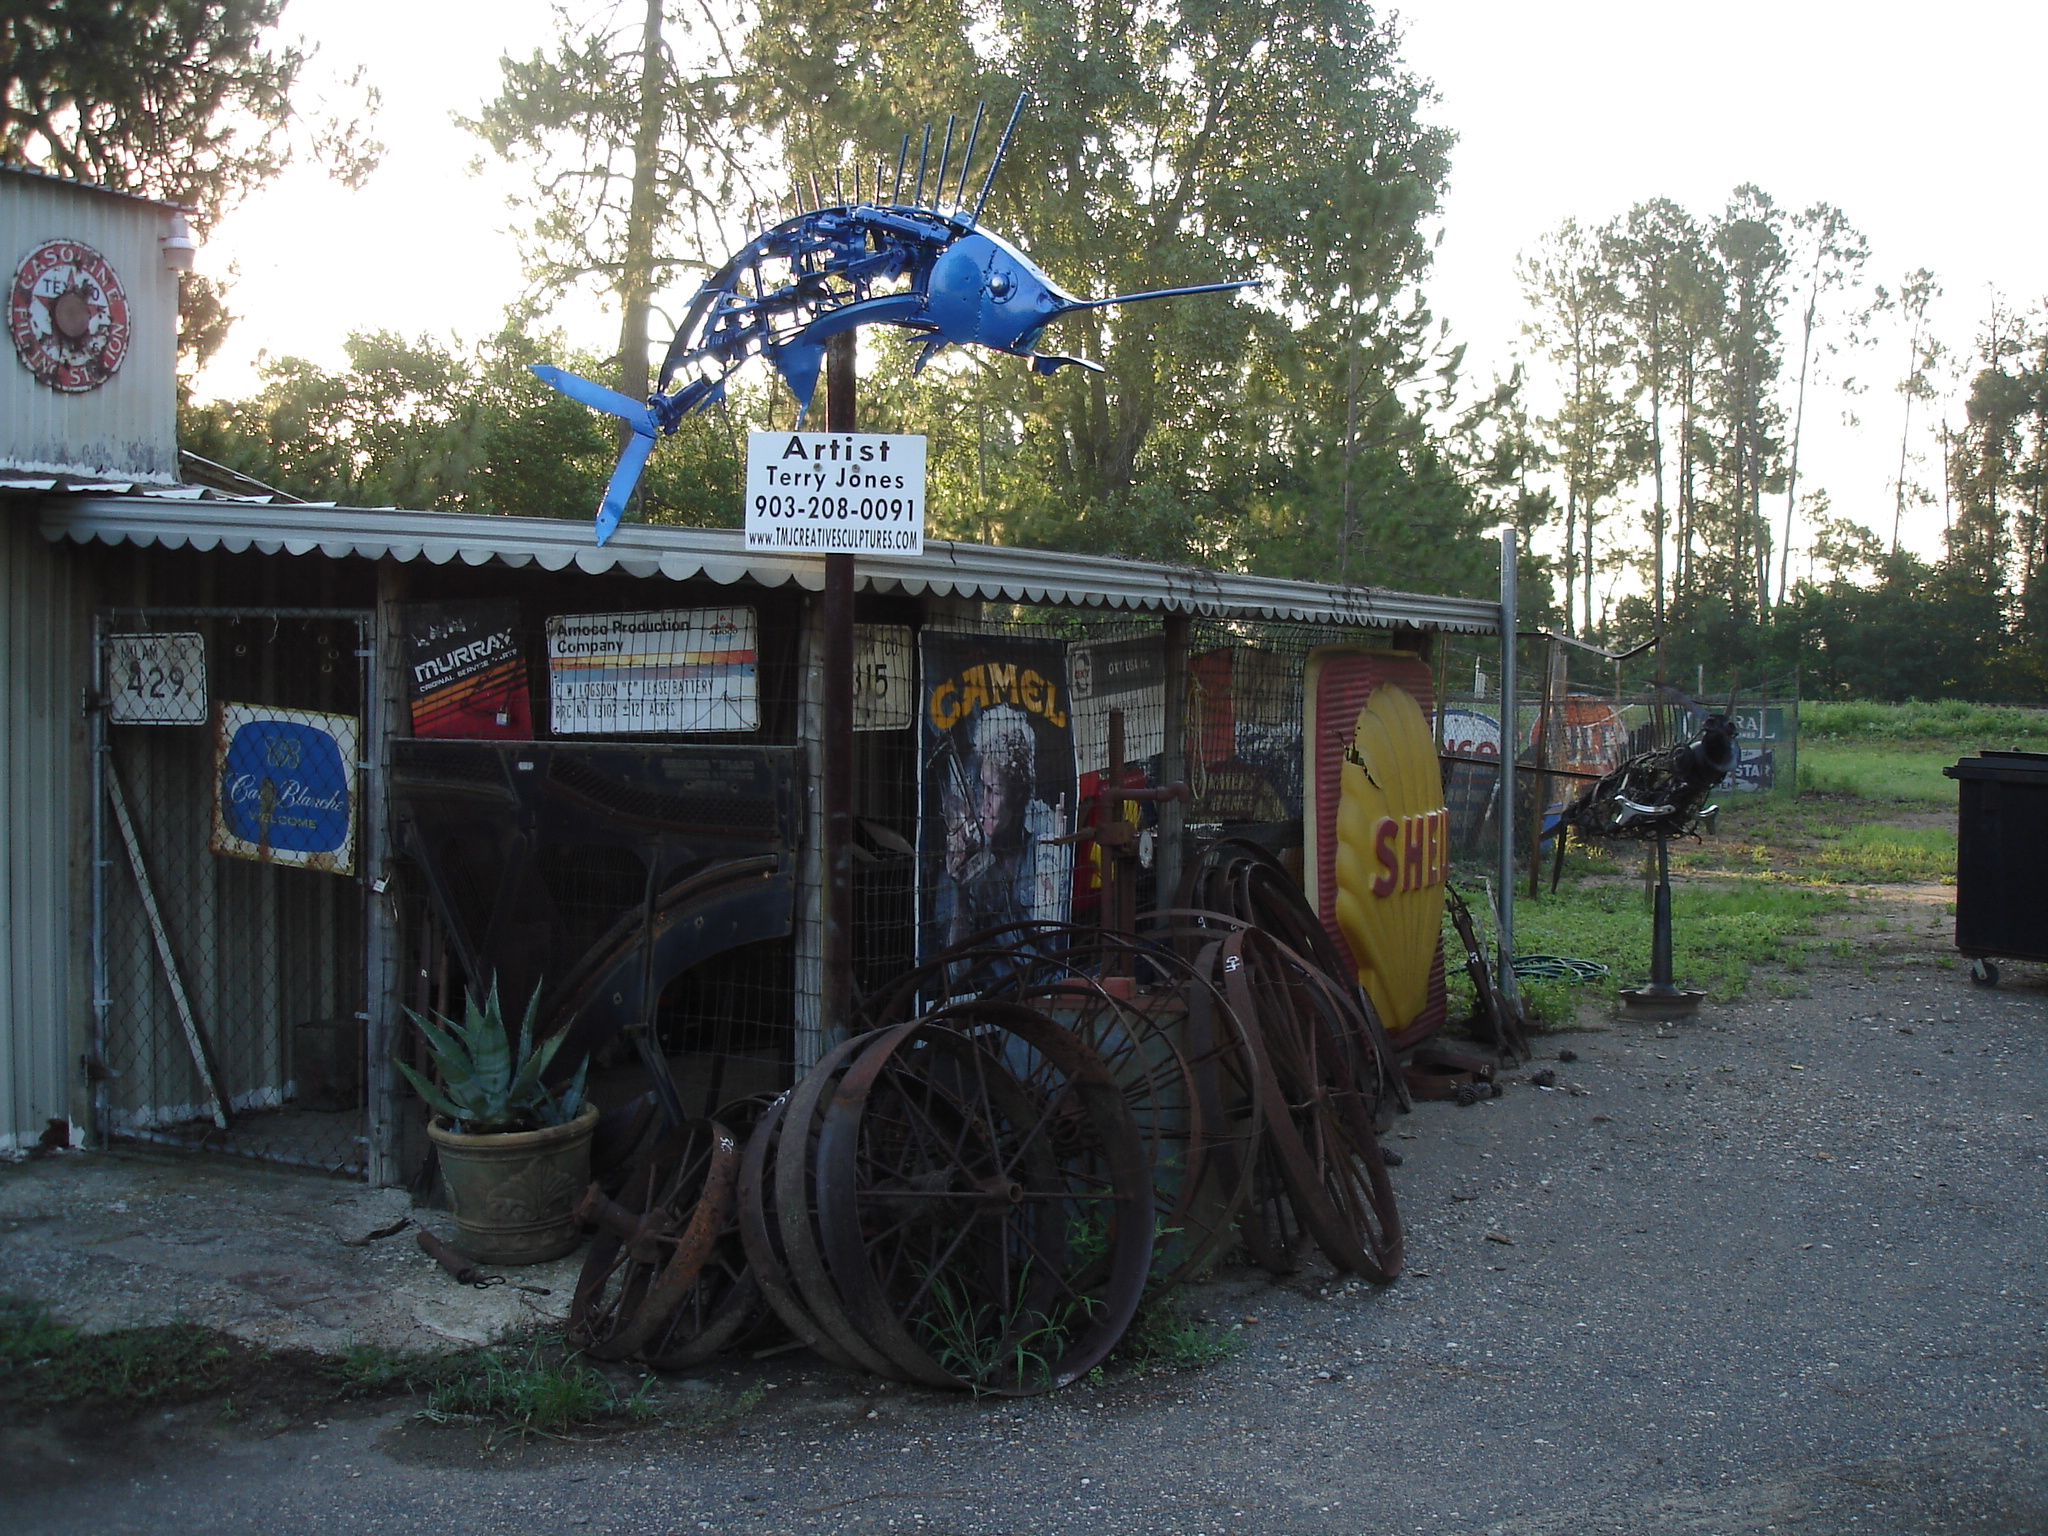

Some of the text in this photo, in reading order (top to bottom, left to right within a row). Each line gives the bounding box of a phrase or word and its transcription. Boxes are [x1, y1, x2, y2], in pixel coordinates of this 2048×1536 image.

[21, 246, 121, 302] GASOINE
[782, 435, 890, 462] Artist
[766, 466, 904, 492] Terry Jones
[755, 495, 914, 521] 903-208-0091
[557, 617, 690, 638] Amoco Production
[709, 628, 739, 636] AMOCO
[413, 626, 513, 683] MURRAY
[557, 640, 624, 657] Company
[128, 662, 185, 698] 429
[579, 683, 618, 697] LOGSDON
[642, 680, 669, 696] LEASE
[672, 679, 714, 695] BATTERY
[930, 662, 1067, 729] CAMEL
[649, 702, 676, 717] ACRES
[277, 779, 345, 812] Blanche
[249, 808, 317, 830] WELCOME
